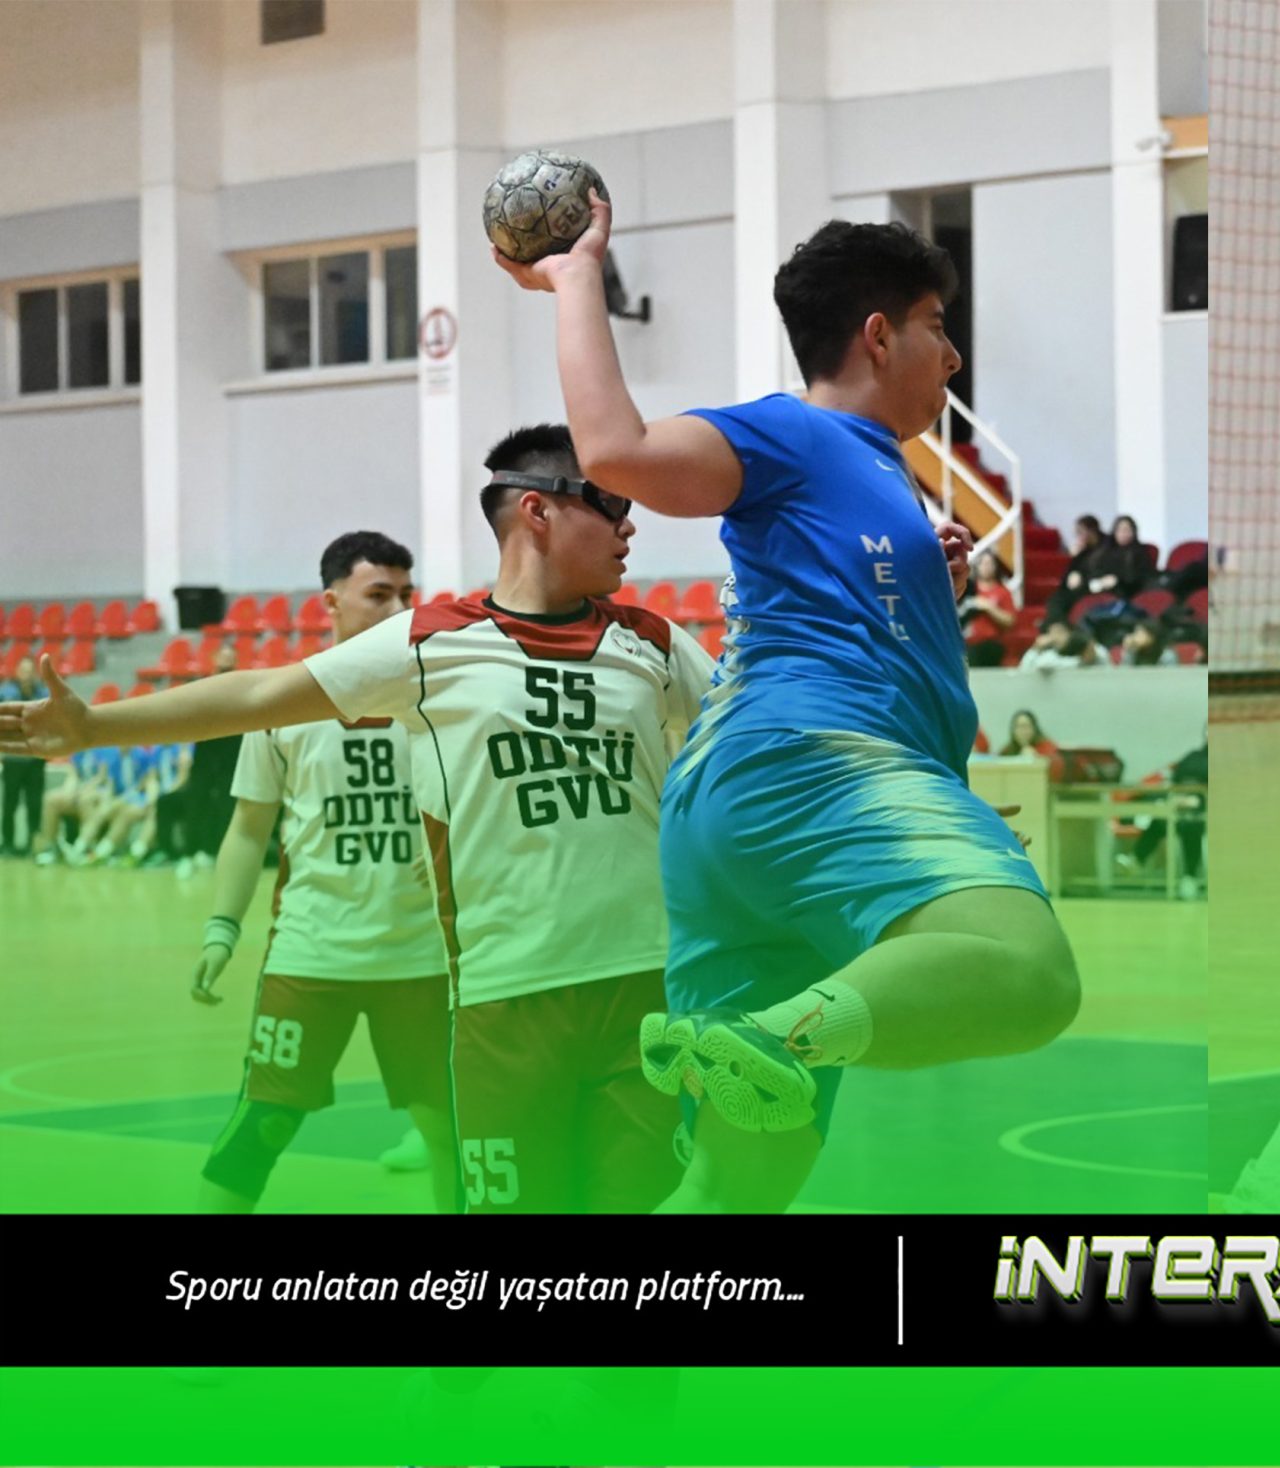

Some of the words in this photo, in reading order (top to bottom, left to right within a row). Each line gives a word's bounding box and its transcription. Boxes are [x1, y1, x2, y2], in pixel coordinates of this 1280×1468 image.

[525, 666, 596, 731] 55
[343, 738, 396, 788] 58
[487, 730, 635, 782] ODTÜ
[335, 831, 412, 866] GVO
[250, 1015, 303, 1069] 58
[462, 1138, 519, 1205] 55
